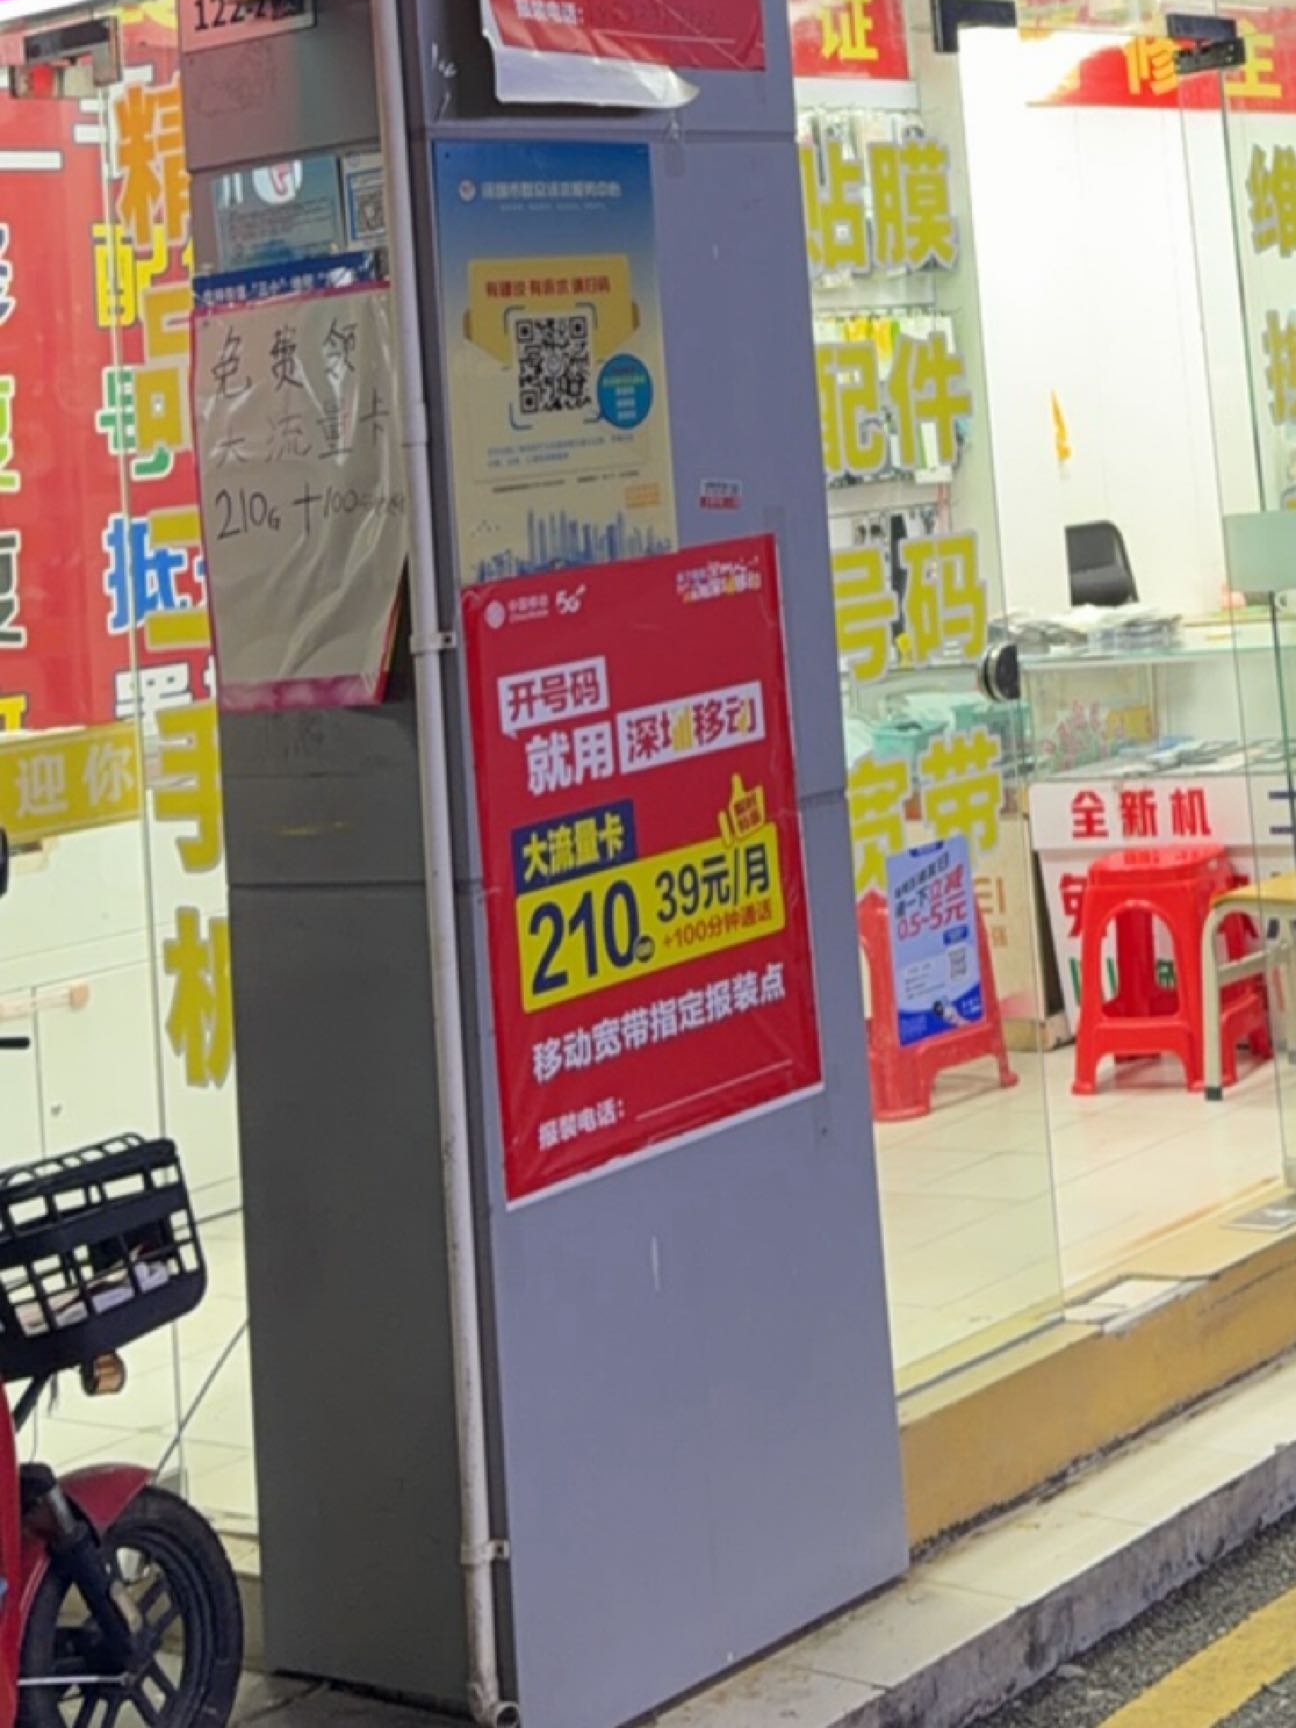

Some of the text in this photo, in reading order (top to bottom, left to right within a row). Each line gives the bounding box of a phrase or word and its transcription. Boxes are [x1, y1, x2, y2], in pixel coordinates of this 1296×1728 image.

[829, 529, 989, 680] 号码
[507, 667, 599, 722] 开号码
[525, 696, 757, 797] 就用 深圳移动
[522, 810, 626, 882] 大流量卡
[1071, 787, 1212, 841] 全新机
[528, 842, 770, 996] 210 39元/月
[663, 897, 773, 949] +100分钟通话
[532, 962, 785, 1083] 移动宽带指定报装点
